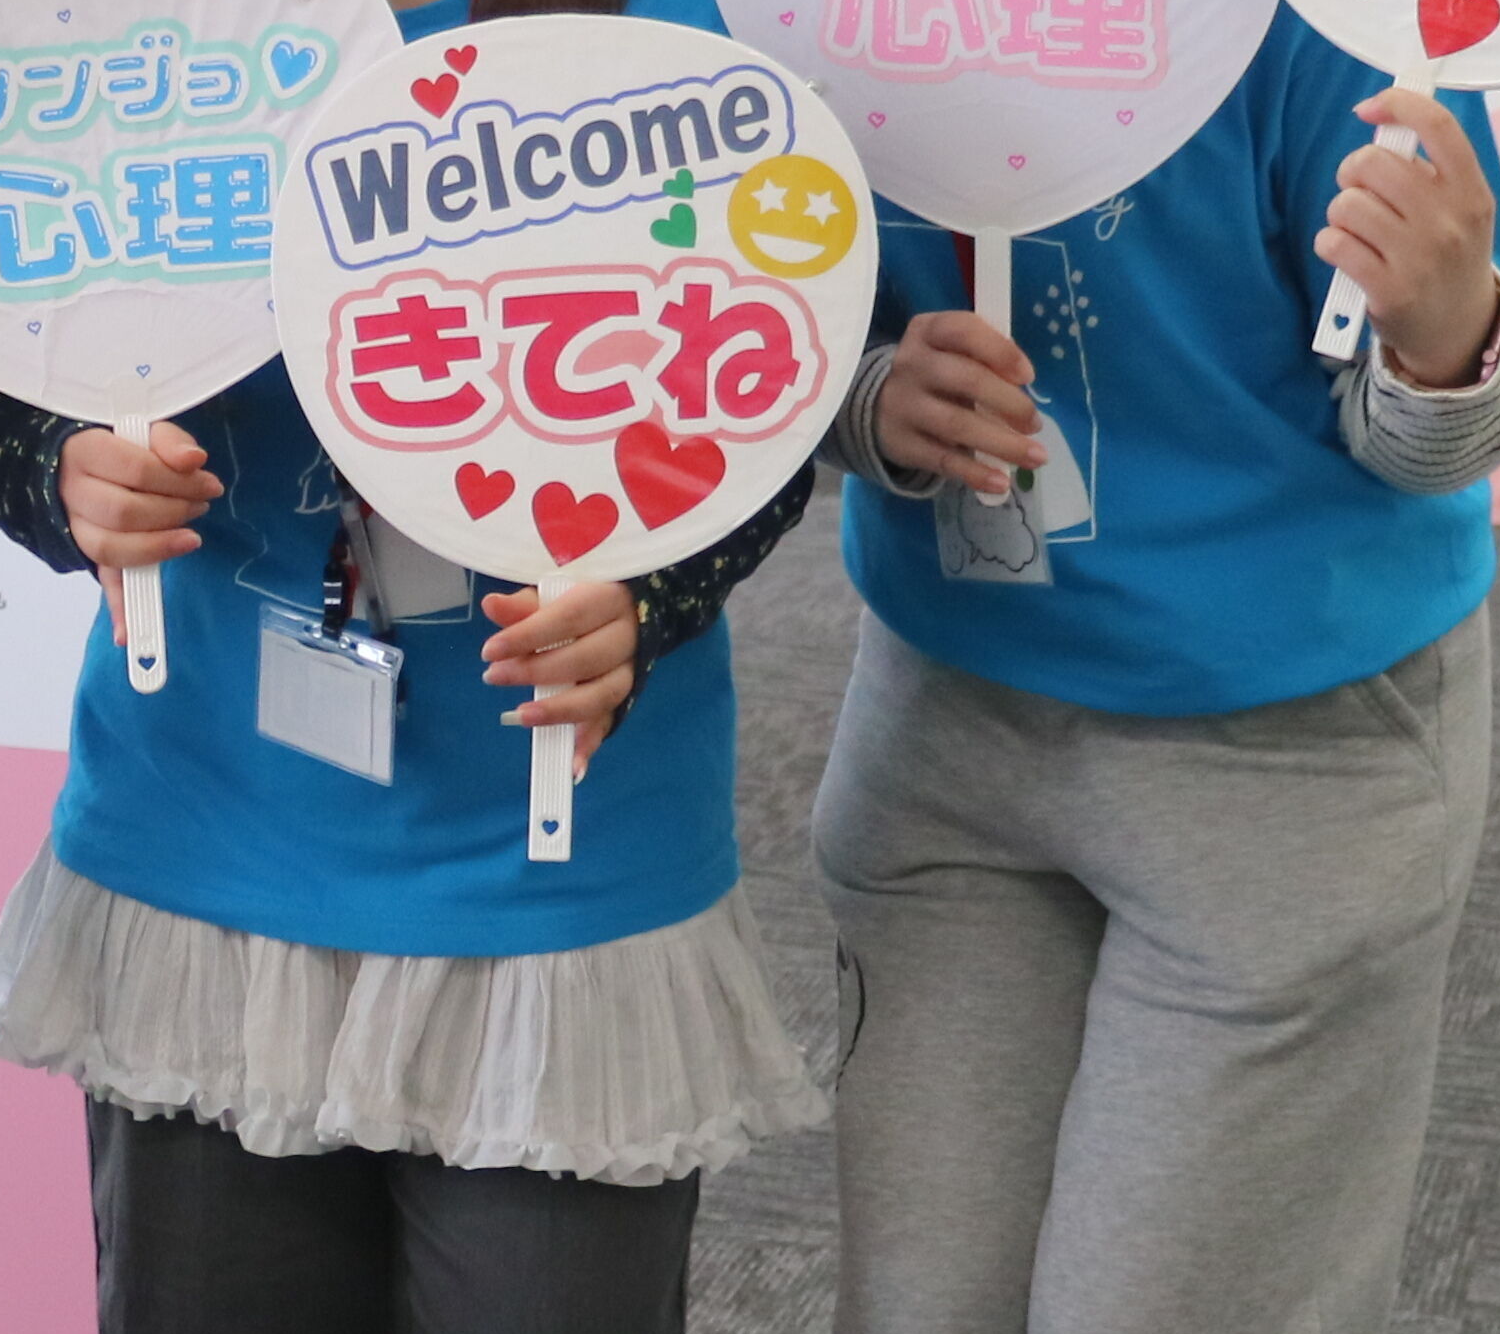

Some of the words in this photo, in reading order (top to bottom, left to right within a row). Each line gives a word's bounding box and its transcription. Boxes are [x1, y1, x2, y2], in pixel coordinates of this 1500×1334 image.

[328, 84, 771, 245] Welcome
[350, 282, 801, 428] きてね
